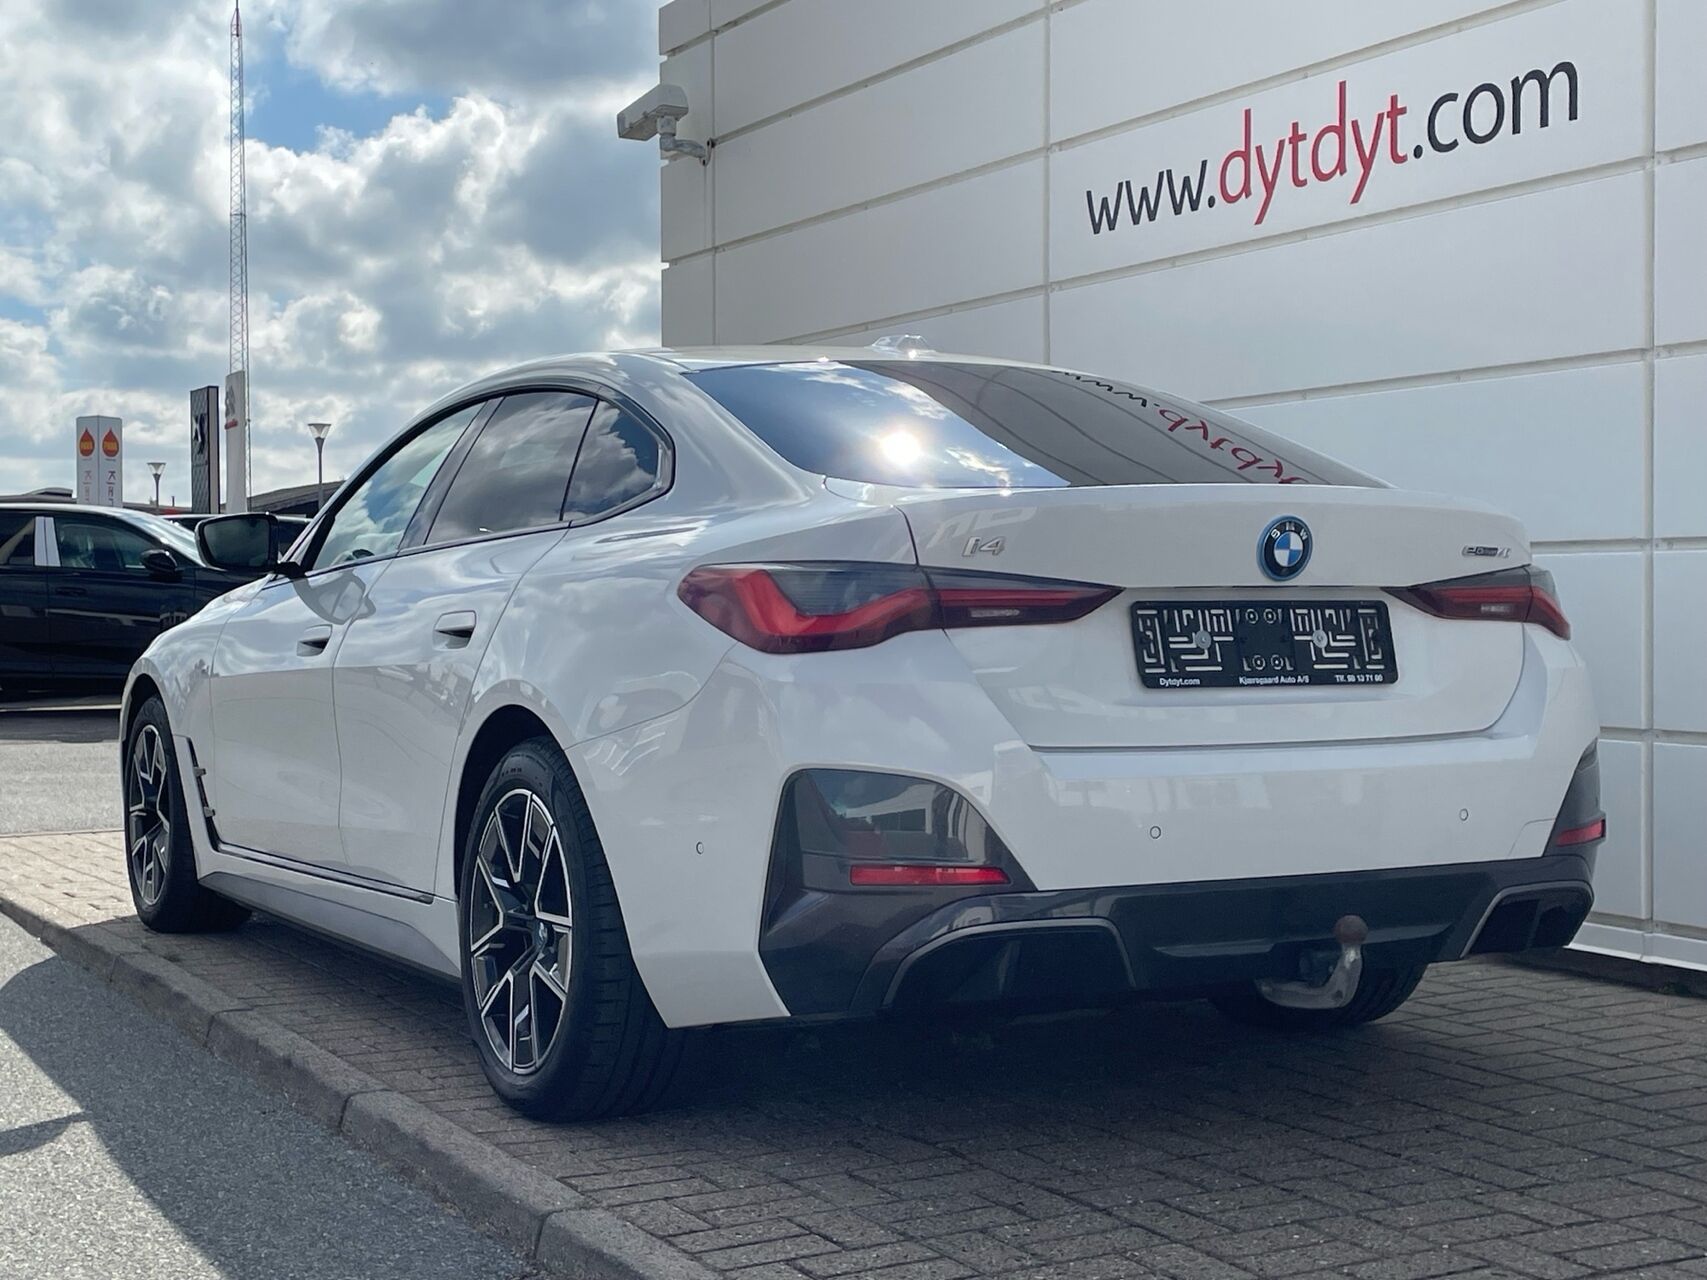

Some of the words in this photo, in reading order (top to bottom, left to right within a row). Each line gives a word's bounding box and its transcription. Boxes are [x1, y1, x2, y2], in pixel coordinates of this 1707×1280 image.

[1086, 60, 1579, 235] www.dytdyt.com
[1270, 521, 1308, 541] BMW
[1280, 675, 1296, 684] Auto
